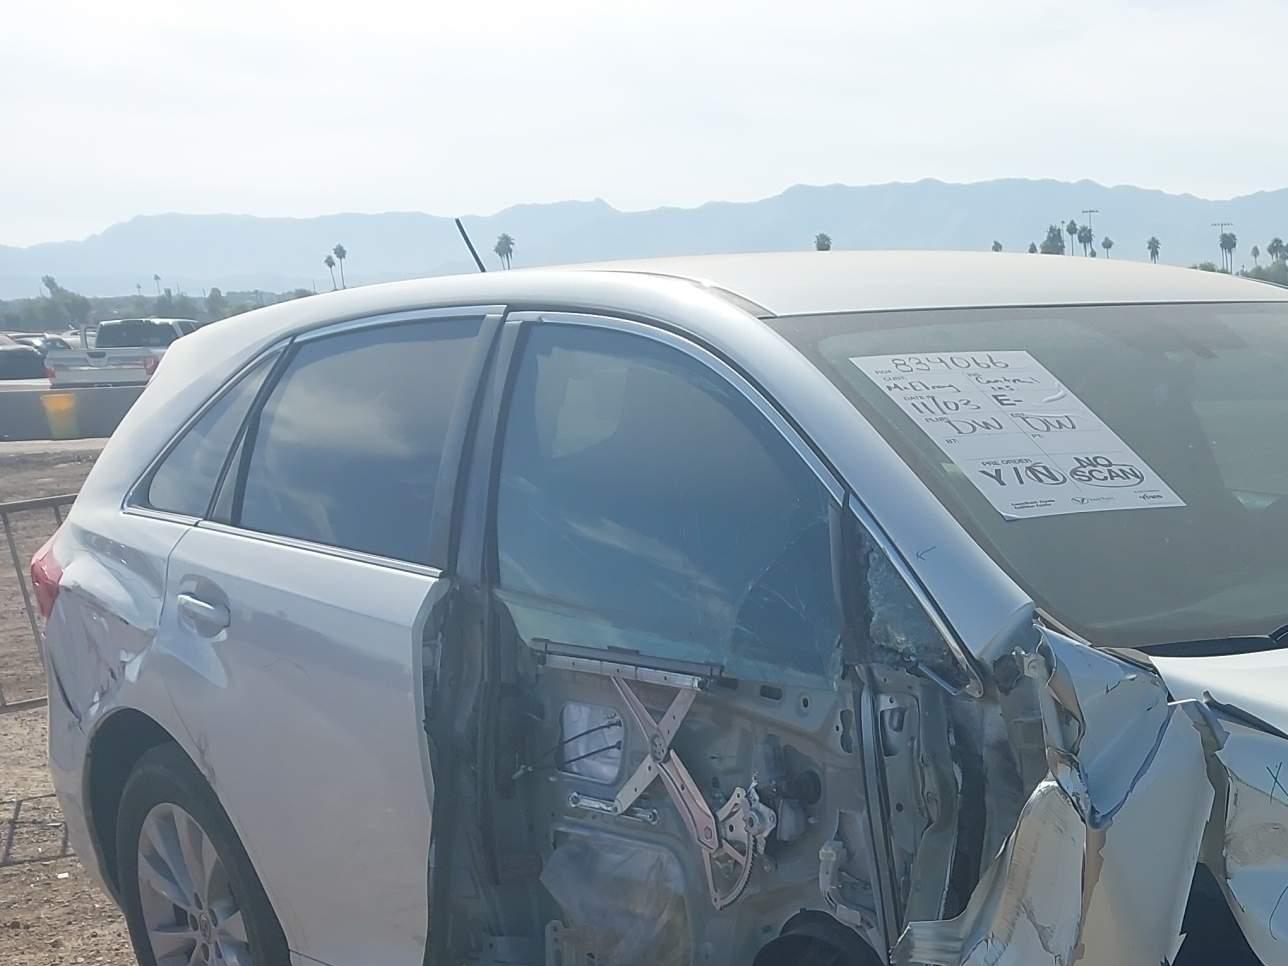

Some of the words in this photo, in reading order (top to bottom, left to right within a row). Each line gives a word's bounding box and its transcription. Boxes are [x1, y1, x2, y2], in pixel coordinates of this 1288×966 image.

[891, 353, 1009, 373] 834066
[946, 417, 1004, 435] DW
[1073, 456, 1113, 468] NO
[1072, 467, 1142, 482] SCAN
